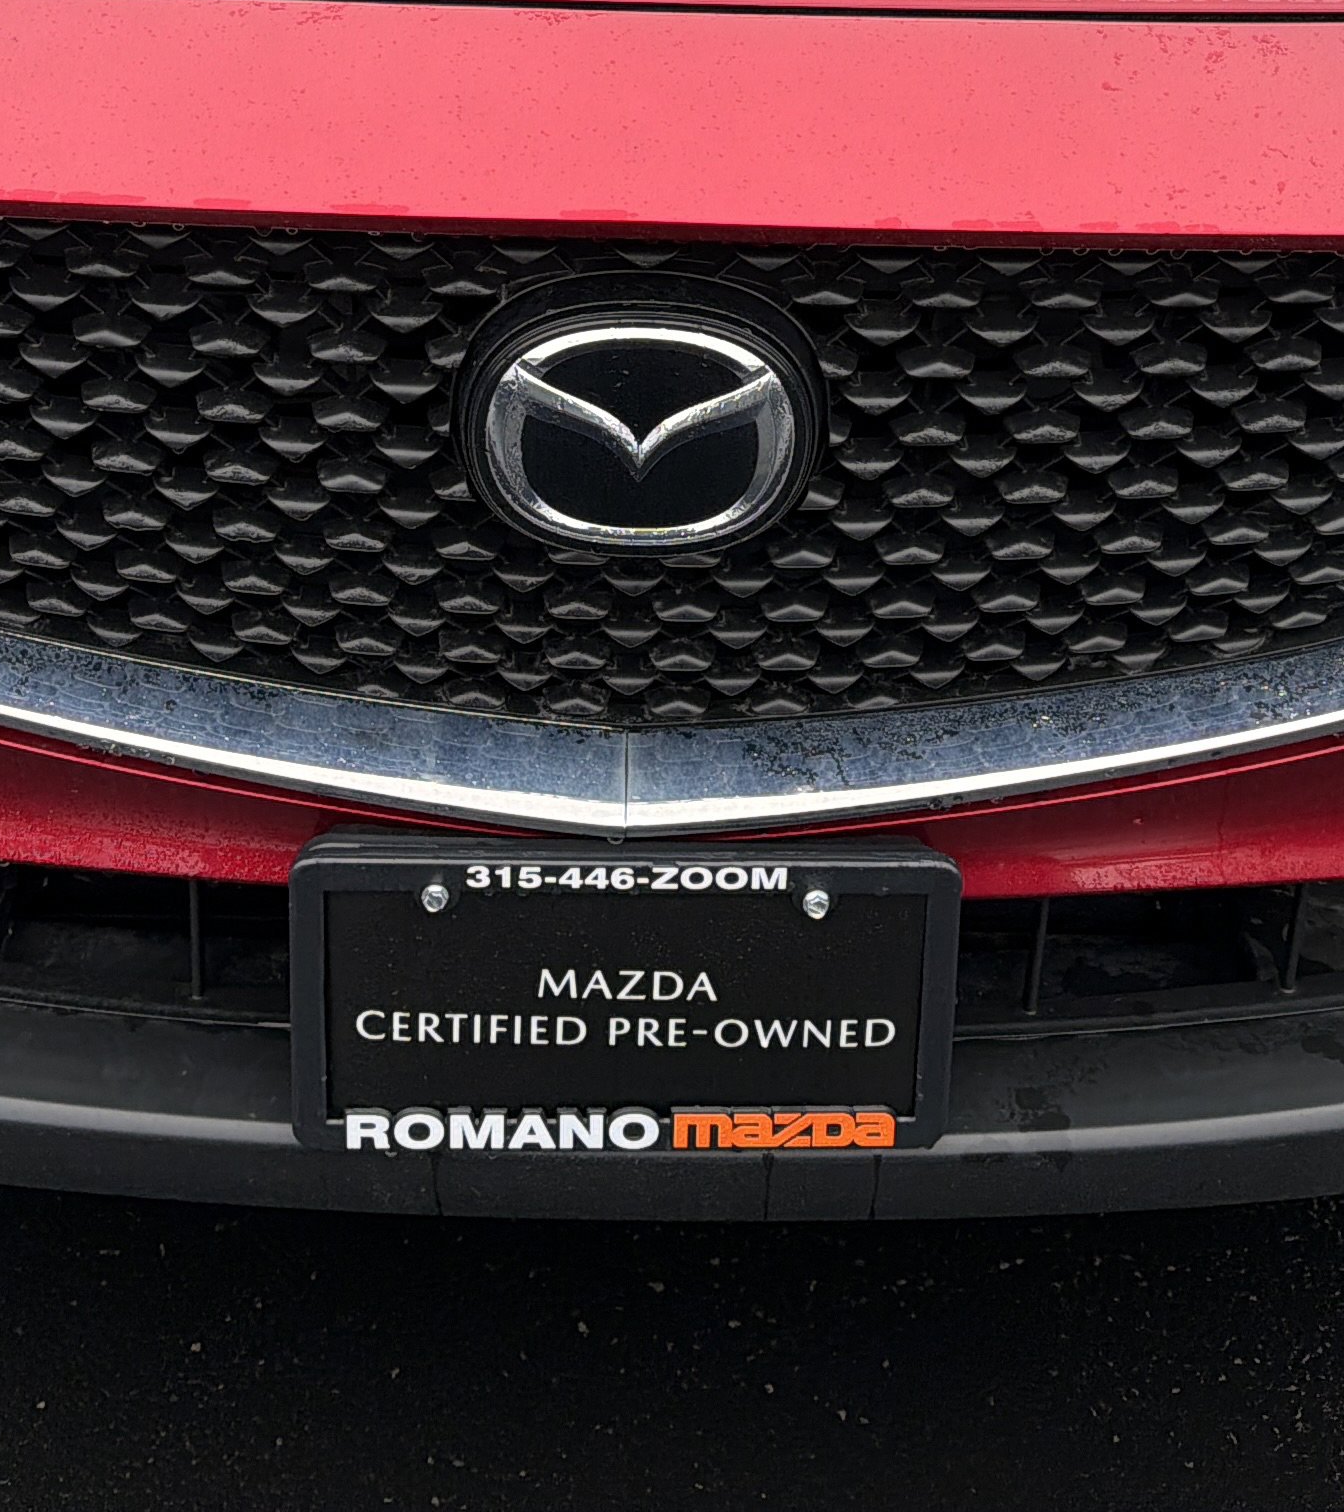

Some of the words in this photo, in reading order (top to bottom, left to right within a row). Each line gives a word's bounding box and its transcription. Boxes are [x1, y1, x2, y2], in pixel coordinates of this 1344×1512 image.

[465, 865, 788, 892] 315-446-ZOOM
[537, 968, 718, 1002] MAZDA
[355, 1009, 588, 1046] CERTIFIED
[608, 1017, 897, 1049] PRE-OWNED
[346, 1113, 661, 1150] ROMANO
[673, 1111, 896, 1149] mazda
